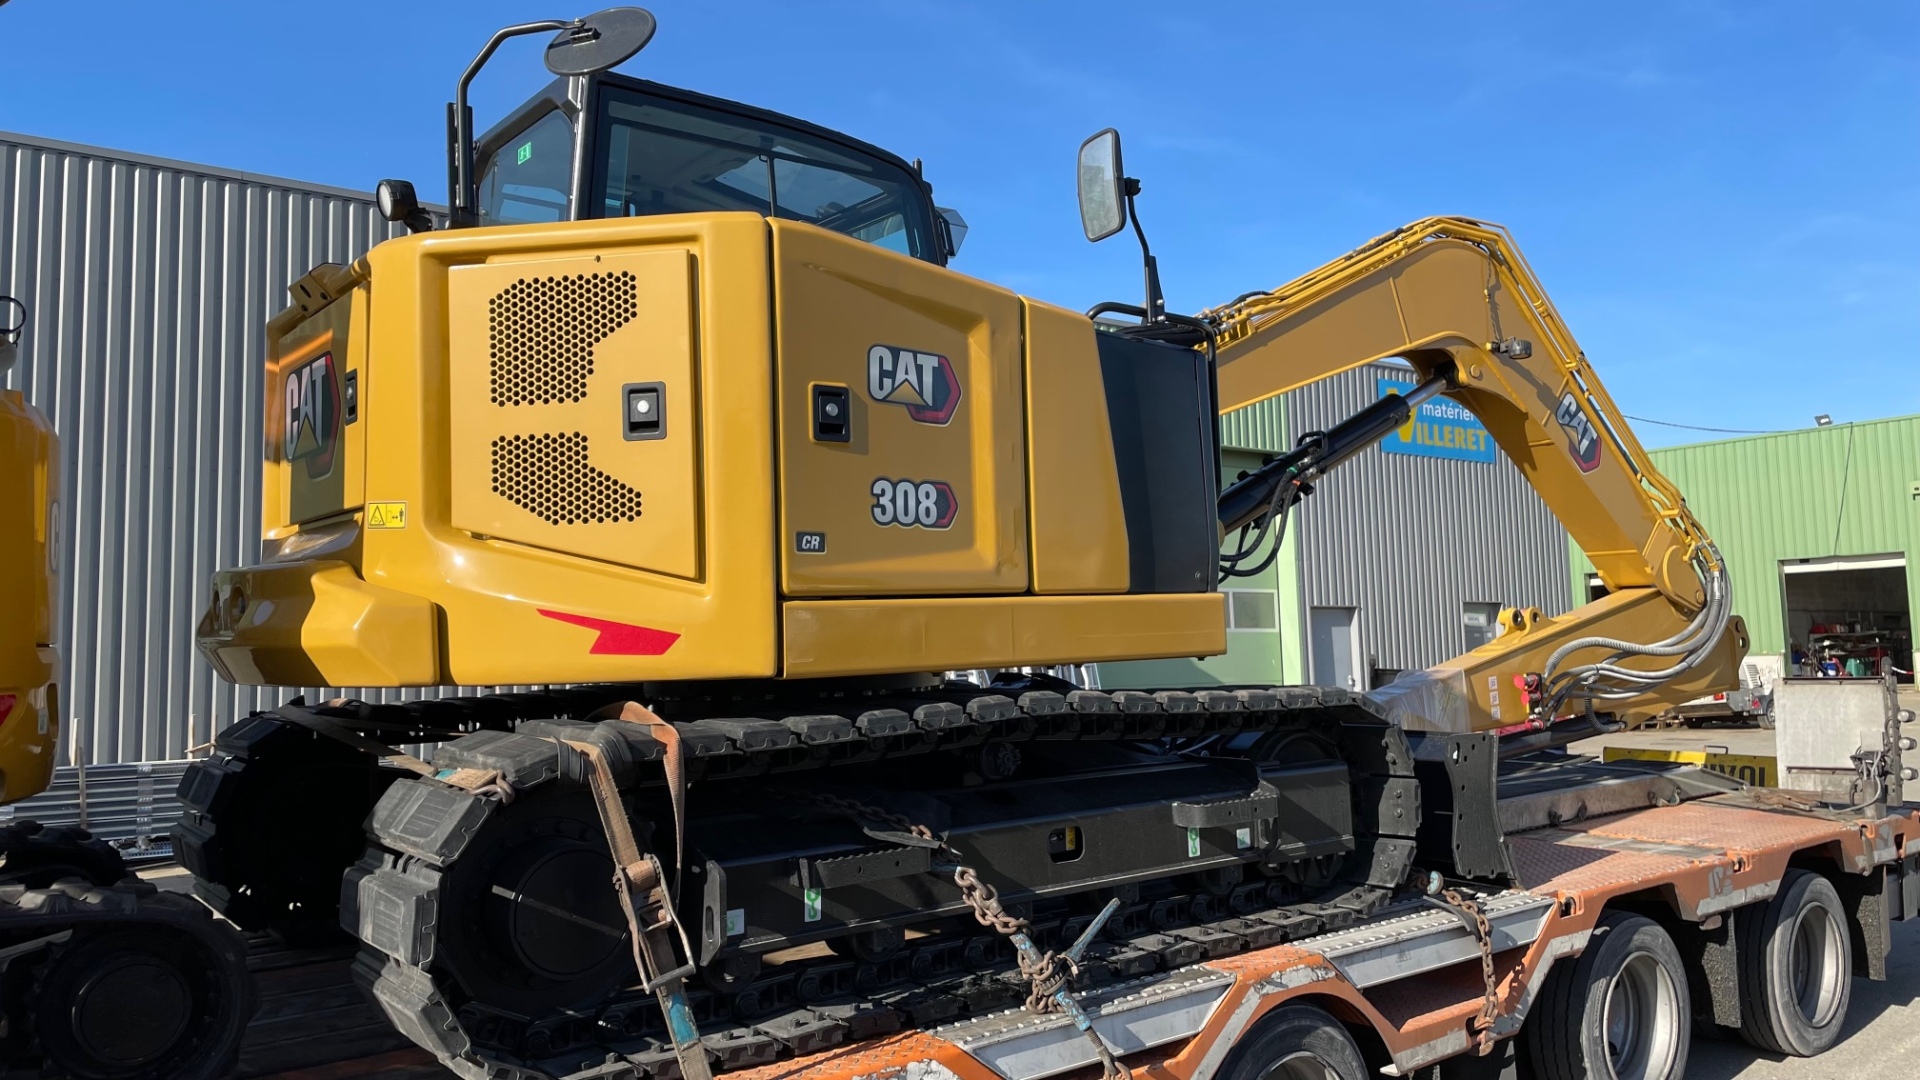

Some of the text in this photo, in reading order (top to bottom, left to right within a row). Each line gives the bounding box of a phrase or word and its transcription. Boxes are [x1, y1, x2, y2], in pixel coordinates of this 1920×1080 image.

[868, 346, 939, 407] CAT
[286, 356, 327, 461] CAT
[1556, 392, 1598, 456] CAT
[872, 479, 938, 526] 308
[801, 534, 820, 550] CR
